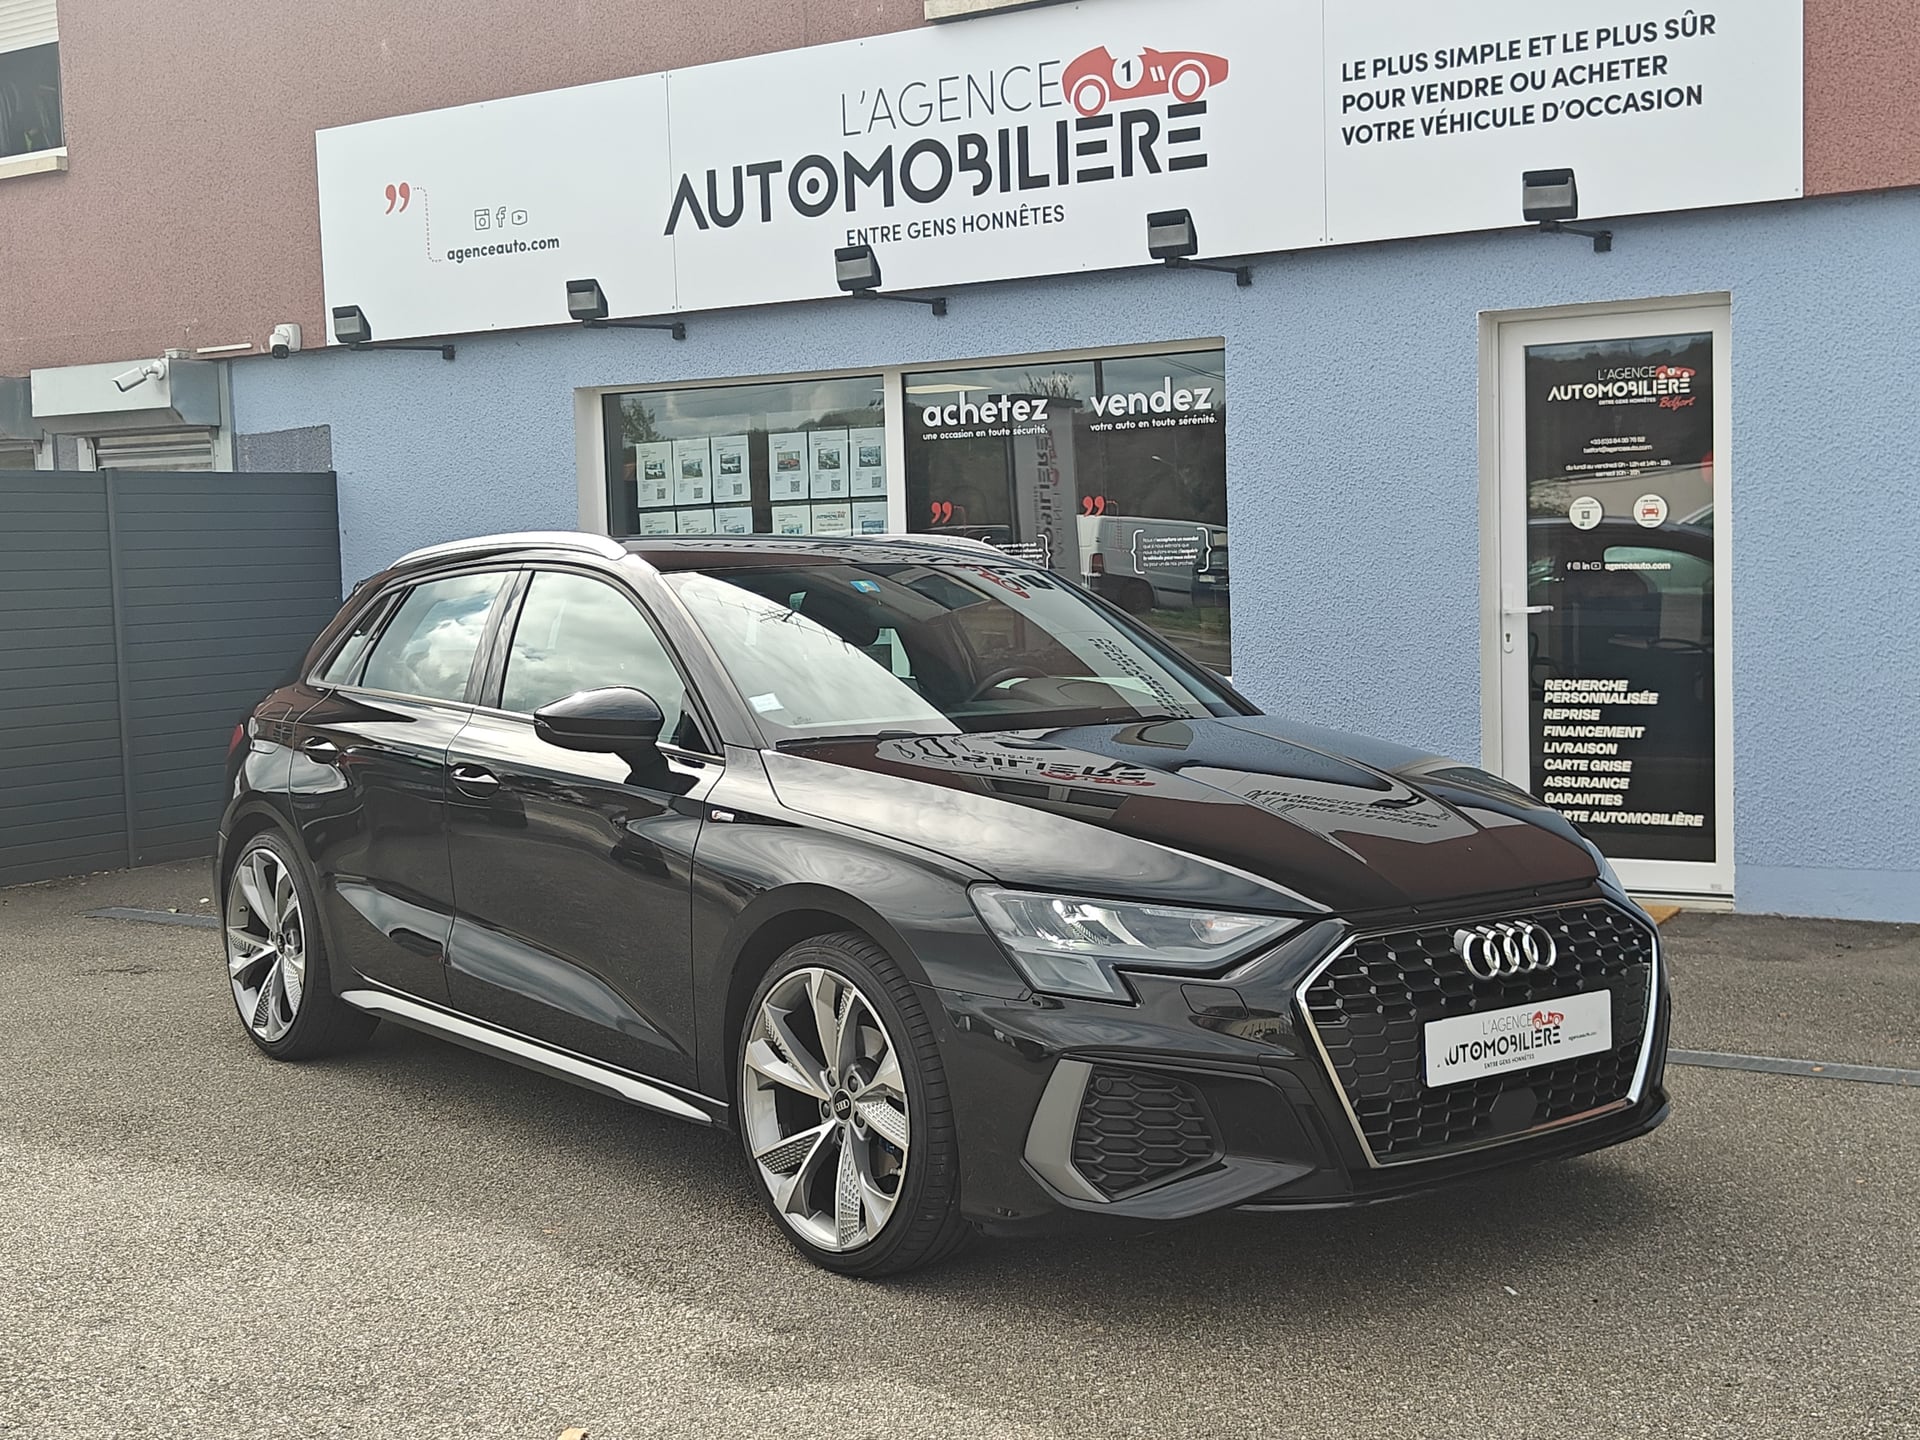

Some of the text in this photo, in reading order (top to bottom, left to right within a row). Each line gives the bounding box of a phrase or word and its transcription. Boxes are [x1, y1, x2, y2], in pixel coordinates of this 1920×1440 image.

[1341, 9, 1717, 83] LE PLUS SIMPLE ET LE PLUS SÛR
[1341, 54, 1669, 115] POUR VENDRE OU ACHETER
[1341, 119, 1416, 147] VOTRE
[1420, 105, 1536, 138] VÉHICULE
[846, 203, 1065, 247] ENTRE GENS HONNÊTES
[446, 235, 560, 264] agenceauto.com
[1090, 376, 1212, 417] vendez
[1659, 395, 1696, 411] Belfort
[922, 390, 1048, 427] achetez
[1090, 413, 1218, 432] votre auto en toute sérénité.
[922, 423, 1048, 442] une occasion en toute sécurité.
[1604, 562, 1671, 571] agenceauto.com
[1544, 679, 1629, 692] RECHERCHE
[1544, 690, 1659, 705] PERSONNALISÉE
[1543, 708, 1601, 721] REPRISE
[1543, 726, 1645, 739] FINANCEMENT
[1543, 742, 1618, 755] LIVRAISON
[1544, 759, 1633, 773] CARTE GRISE
[1543, 776, 1630, 789] ASSURANCE
[1544, 792, 1623, 806] GARANTIES
[1590, 811, 1704, 827] AUTOMOBILIÈRE
